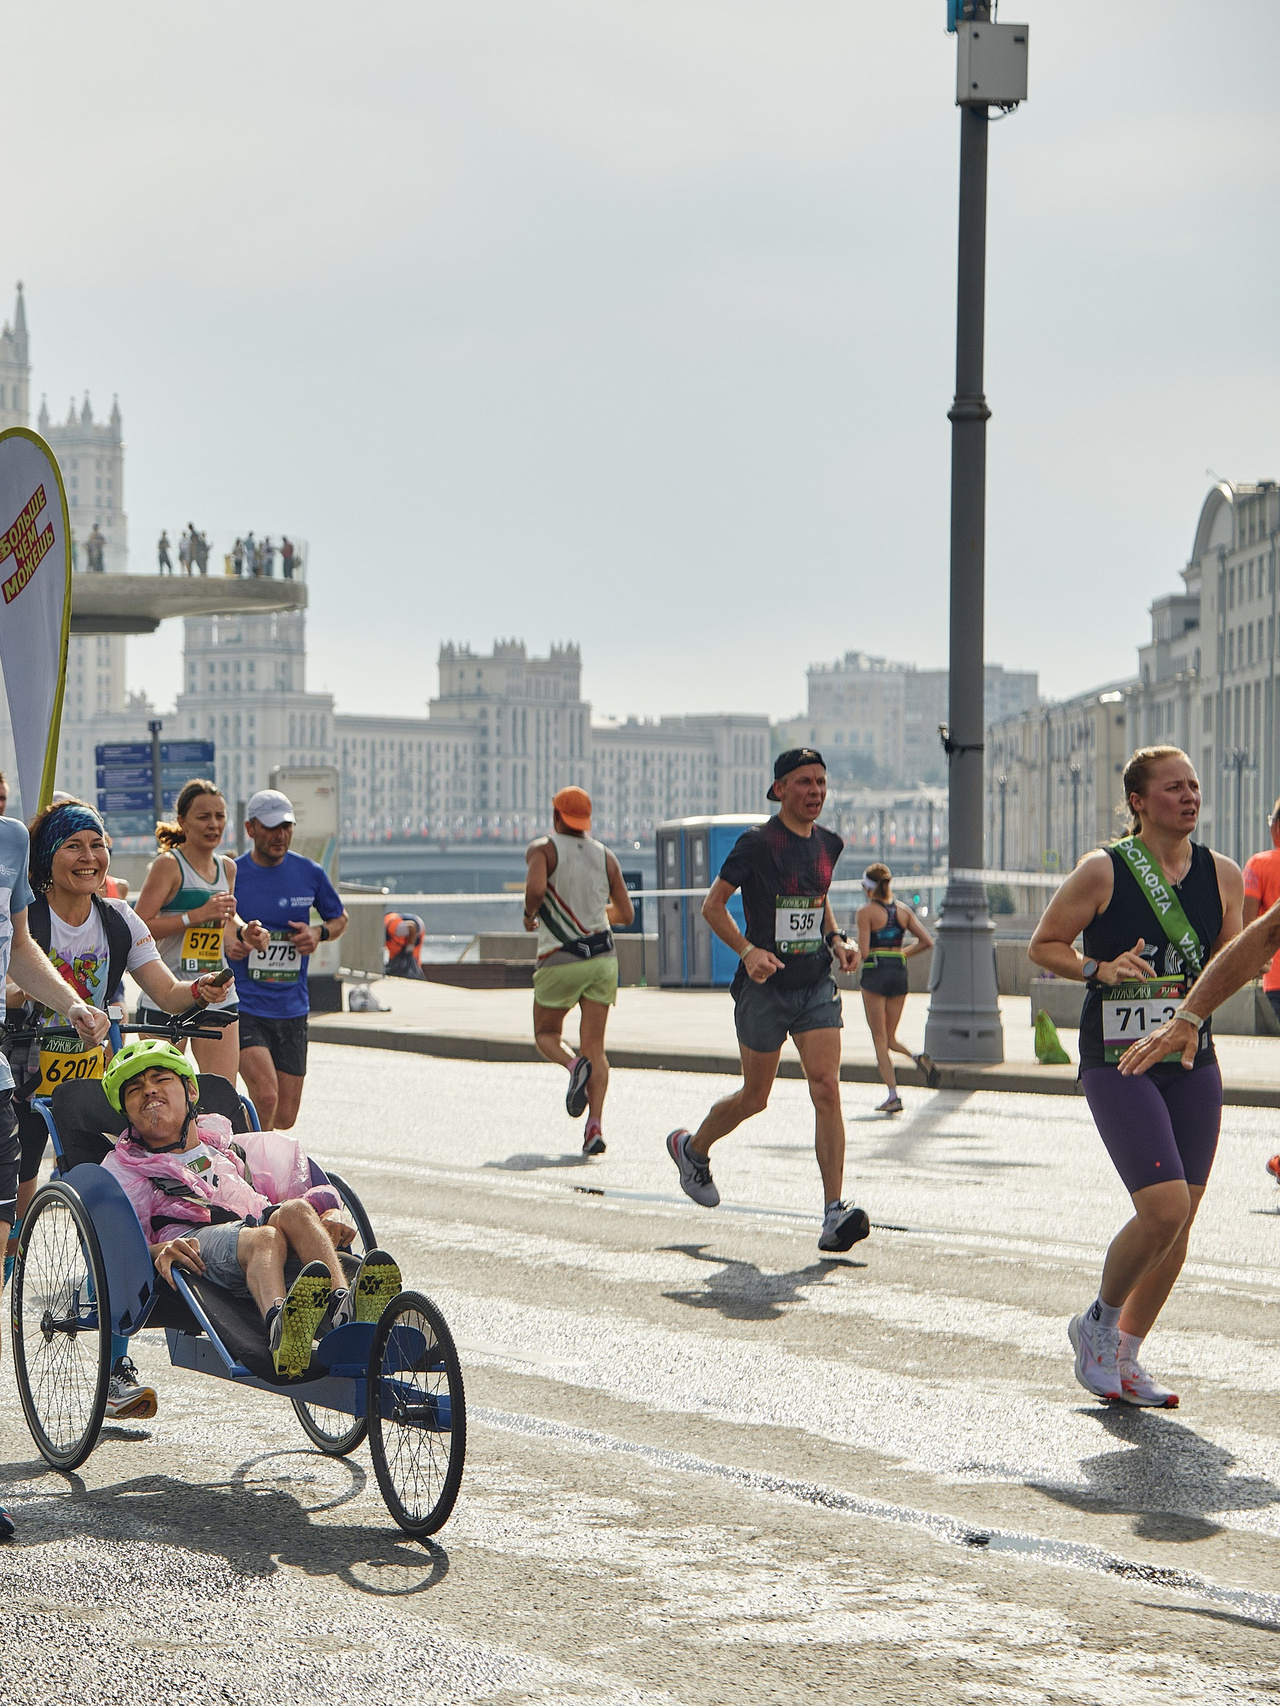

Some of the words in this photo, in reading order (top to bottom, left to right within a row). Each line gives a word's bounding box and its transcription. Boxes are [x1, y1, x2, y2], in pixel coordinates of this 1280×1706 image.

[14, 523, 38, 562] ЧЕМ
[4, 530, 54, 602] МОЖЕШЬ
[1118, 838, 1172, 915] ЭСТАФЕТА
[790, 912, 816, 931] 535
[189, 932, 220, 950] 572
[257, 945, 297, 961] 5775
[189, 960, 196, 969] B
[1110, 985, 1151, 1000] ЛУЖНИКИ
[46, 1055, 98, 1082] 6207
